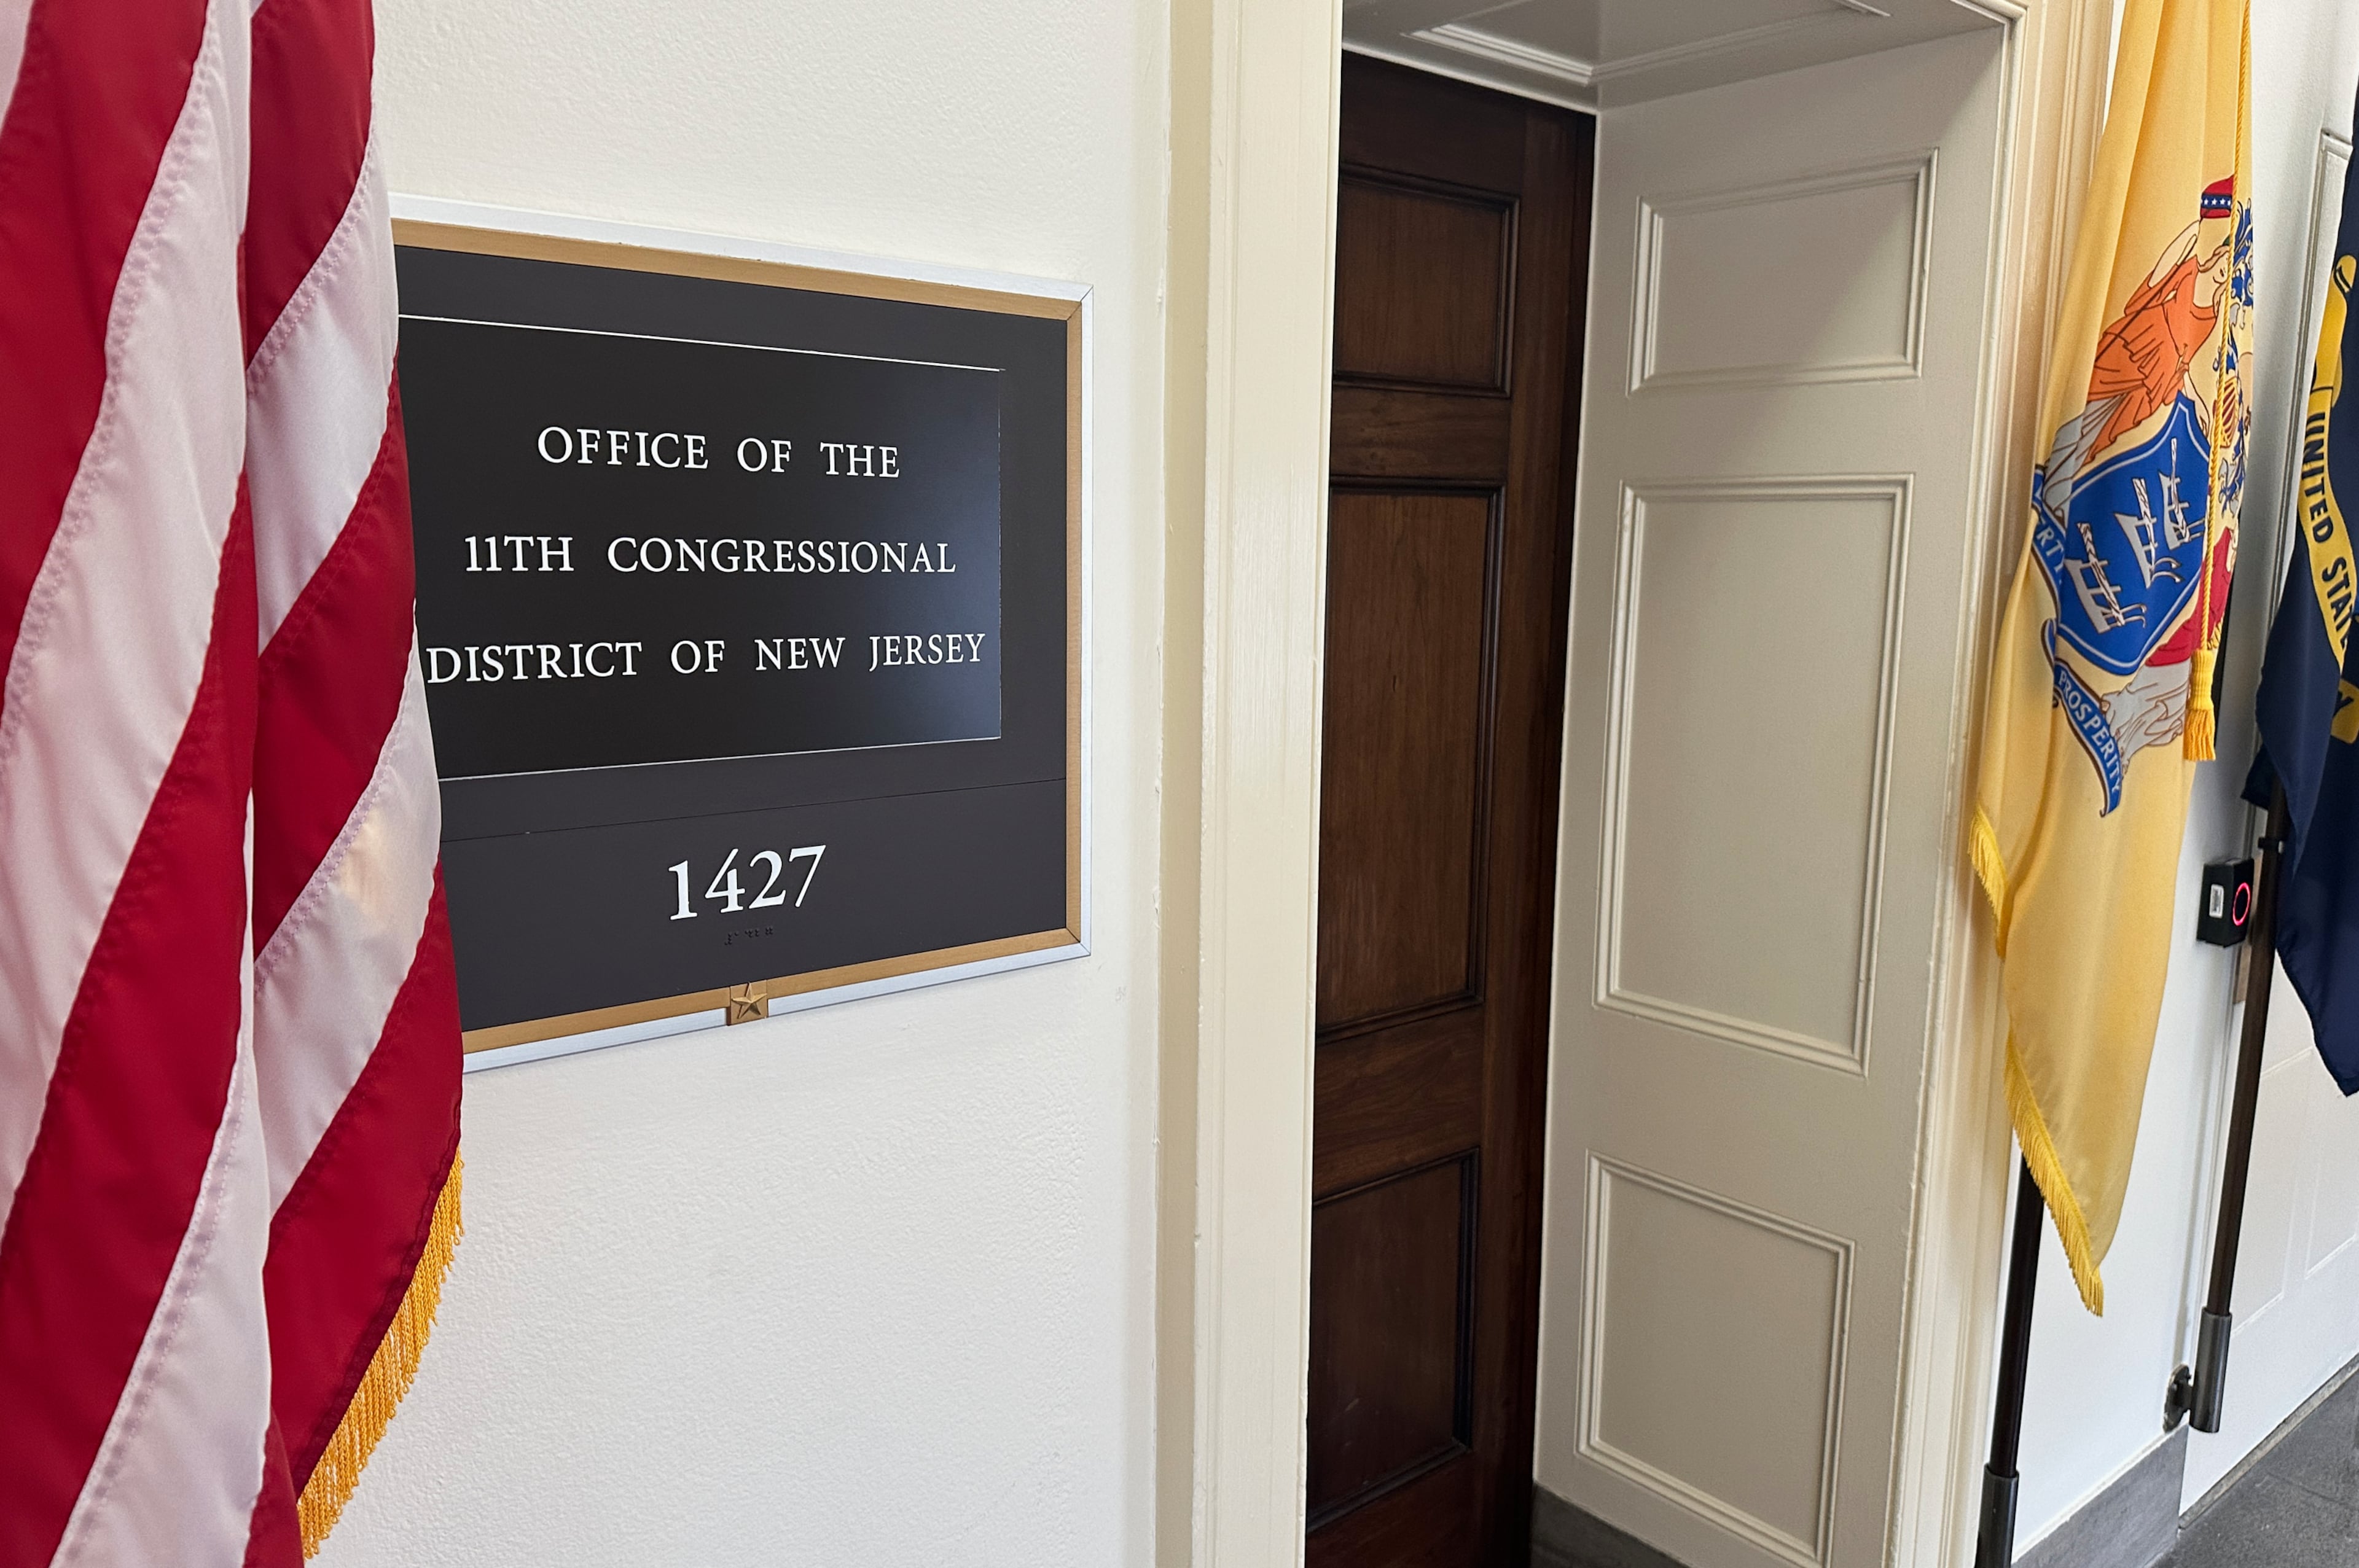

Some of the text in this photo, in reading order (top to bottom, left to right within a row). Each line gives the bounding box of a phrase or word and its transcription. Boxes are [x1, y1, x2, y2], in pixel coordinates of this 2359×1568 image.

[538, 426, 900, 478] OFFICE OF THE
[2301, 412, 2334, 544] UNITED
[464, 535, 956, 573] 11TH CONGRESSIONAL
[426, 633, 986, 684] DISTRICT OF NEW JERSEY
[2058, 669, 2120, 793] PROSPERITY
[668, 844, 826, 920] 1427
